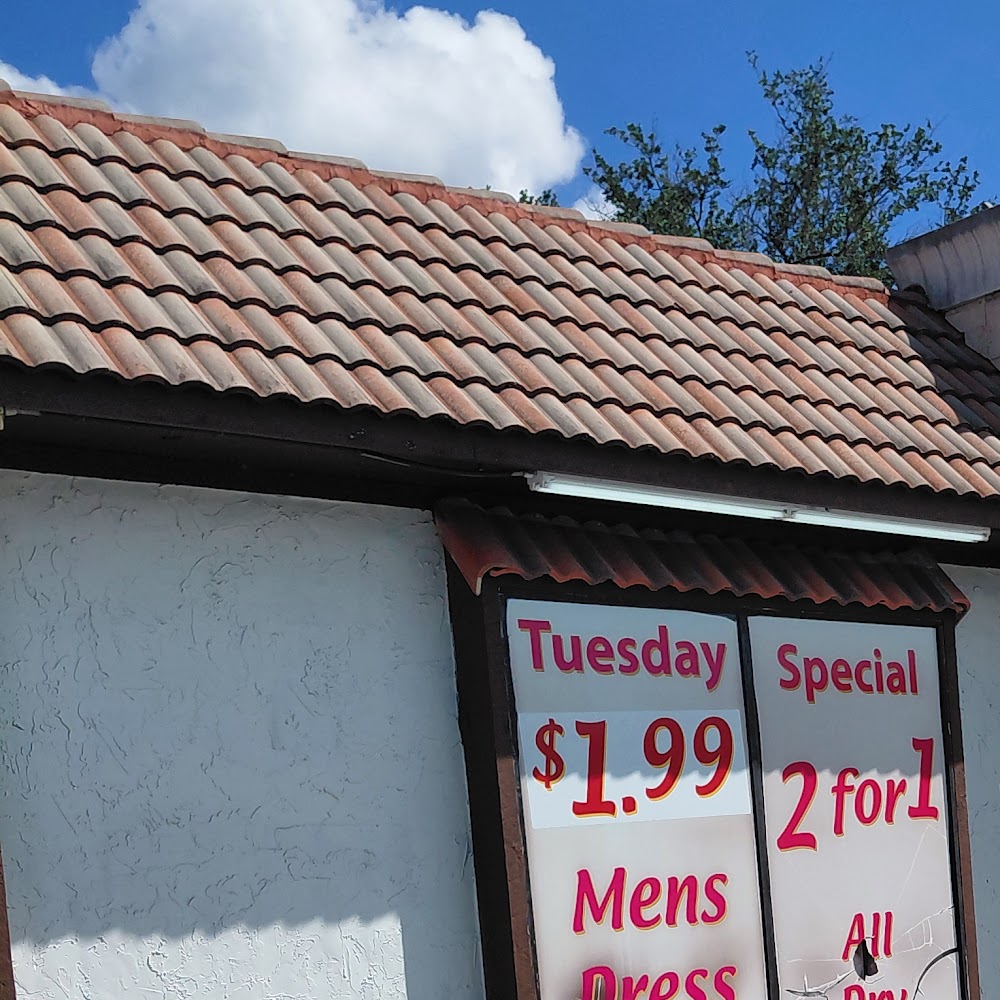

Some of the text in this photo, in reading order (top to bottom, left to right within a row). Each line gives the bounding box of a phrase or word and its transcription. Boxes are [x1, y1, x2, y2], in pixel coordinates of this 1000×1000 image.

[517, 619, 919, 704] Tuesday Special
[532, 716, 734, 818] $1.99
[776, 736, 940, 852] 2 for 1
[572, 867, 729, 935] Mens
[842, 911, 894, 962] All
